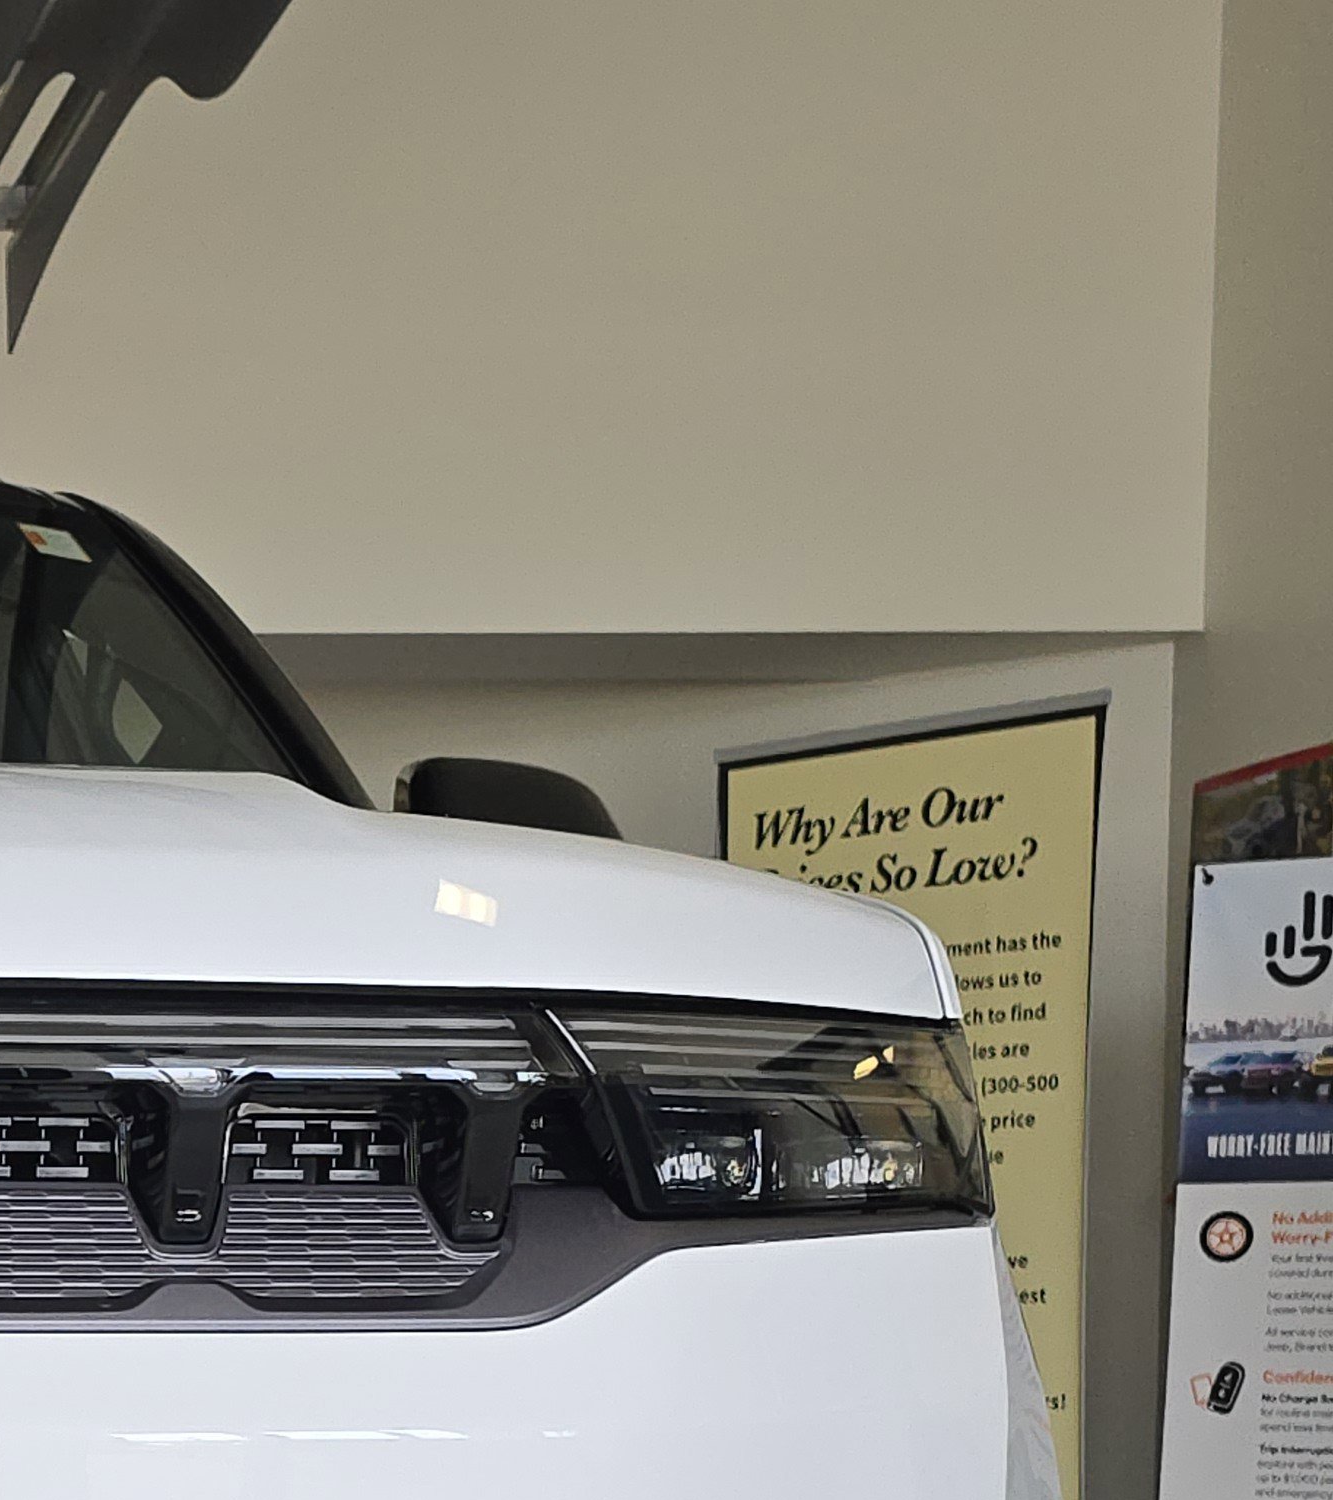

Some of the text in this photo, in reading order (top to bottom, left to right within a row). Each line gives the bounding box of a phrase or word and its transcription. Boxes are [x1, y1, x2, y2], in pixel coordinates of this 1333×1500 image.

[754, 786, 1004, 856] Why Are Our
[870, 853, 918, 894] So
[924, 836, 1038, 888] Low?
[996, 935, 1028, 953] has
[1032, 930, 1062, 950] the
[999, 973, 1020, 988] us
[1024, 970, 1042, 987] to
[988, 1008, 1007, 1025] to
[1011, 1002, 1047, 1022] find
[1001, 1043, 1030, 1059] are
[981, 1073, 1060, 1098] (300-500
[990, 1109, 1036, 1133] price
